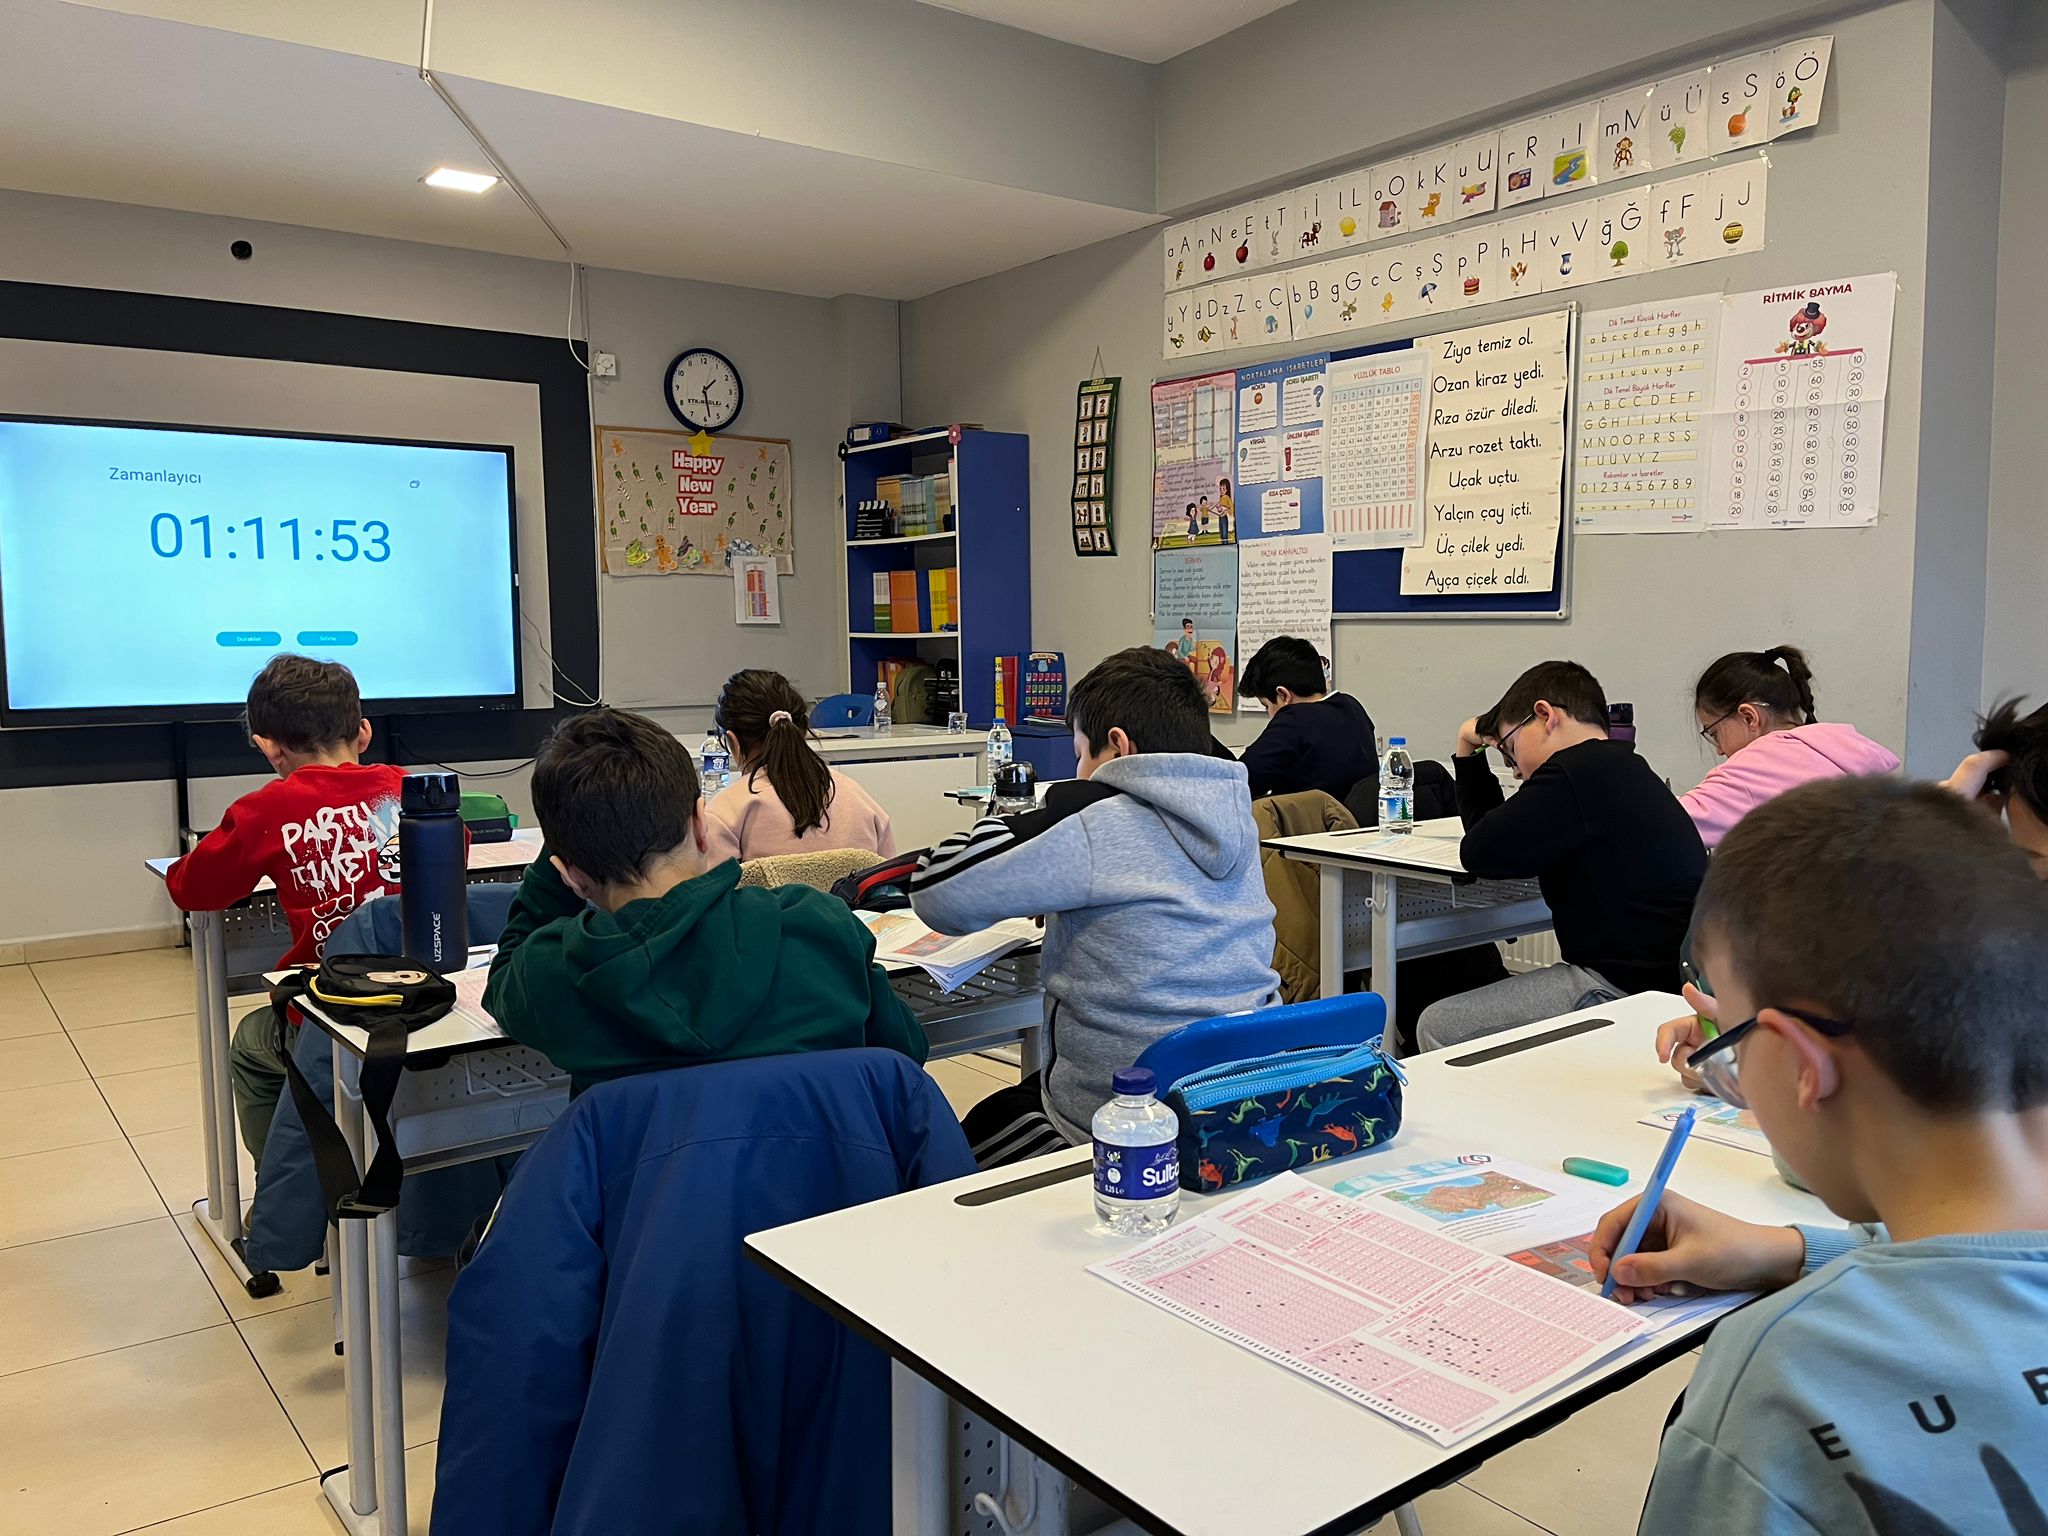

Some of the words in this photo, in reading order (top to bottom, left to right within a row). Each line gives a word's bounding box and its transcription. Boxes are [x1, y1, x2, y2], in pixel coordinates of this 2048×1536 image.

[1763, 289, 1806, 304] RİTMİK
[1810, 284, 1852, 298] SAYMA
[1443, 341, 1471, 363] Ziya
[1478, 336, 1512, 352] temiz
[1518, 328, 1533, 346] ol.
[1812, 360, 1823, 368] 55
[1854, 356, 1862, 364] 10
[1241, 367, 1283, 380] NOKTALAMA
[1353, 369, 1377, 379] YÜZLÜK
[1379, 366, 1400, 375] TABLO
[1434, 376, 1470, 393] Ozan
[1476, 370, 1507, 387] kiraz
[1514, 361, 1544, 388] yedi.
[1811, 376, 1822, 384] 60
[1851, 372, 1861, 380] 20
[1809, 392, 1820, 400] 65
[1849, 388, 1859, 396] 30
[1434, 409, 1459, 426] Rıza
[1466, 406, 1495, 422] özür
[1501, 396, 1538, 417] diledi.
[1774, 411, 1784, 419] 20
[1808, 408, 1818, 416] 70
[1847, 405, 1858, 413] 40
[1774, 426, 1784, 434] 25
[1808, 424, 1818, 432] 75
[1846, 421, 1857, 429] 50
[1430, 442, 1462, 459] Arzu
[1469, 436, 1503, 454] rozet
[1510, 431, 1542, 450] taktı.
[1772, 442, 1782, 450] 30
[1807, 440, 1817, 448] 80
[1846, 438, 1856, 446] 60
[673, 452, 723, 473] Happy
[1772, 458, 1781, 466] 35
[1805, 457, 1816, 465] 85
[1845, 454, 1855, 462] 70
[109, 467, 201, 486] Zamanlayıcı
[680, 476, 713, 492] New
[1449, 471, 1482, 490] Uçak
[1489, 470, 1519, 487] uçtu.
[1735, 476, 1742, 484] 16
[1770, 474, 1780, 482] 40
[1844, 471, 1854, 479] 80
[1734, 491, 1740, 499] 18
[1842, 487, 1853, 495] 90
[679, 498, 716, 514] Year
[1434, 504, 1474, 521] Yalçın
[1480, 509, 1504, 524] çay
[1510, 502, 1532, 518] içti.
[1768, 506, 1777, 514] 50
[1800, 504, 1814, 512] 100
[1840, 503, 1854, 511] 100
[150, 512, 391, 562] 01:11:53
[1436, 533, 1454, 555] Üç
[1461, 536, 1489, 555] çilek
[1496, 534, 1525, 558] yedi.
[1426, 570, 1459, 592] Ayça
[1466, 570, 1497, 586] çiçek
[1504, 568, 1529, 585] aldı.
[281, 801, 378, 864] PARTY
